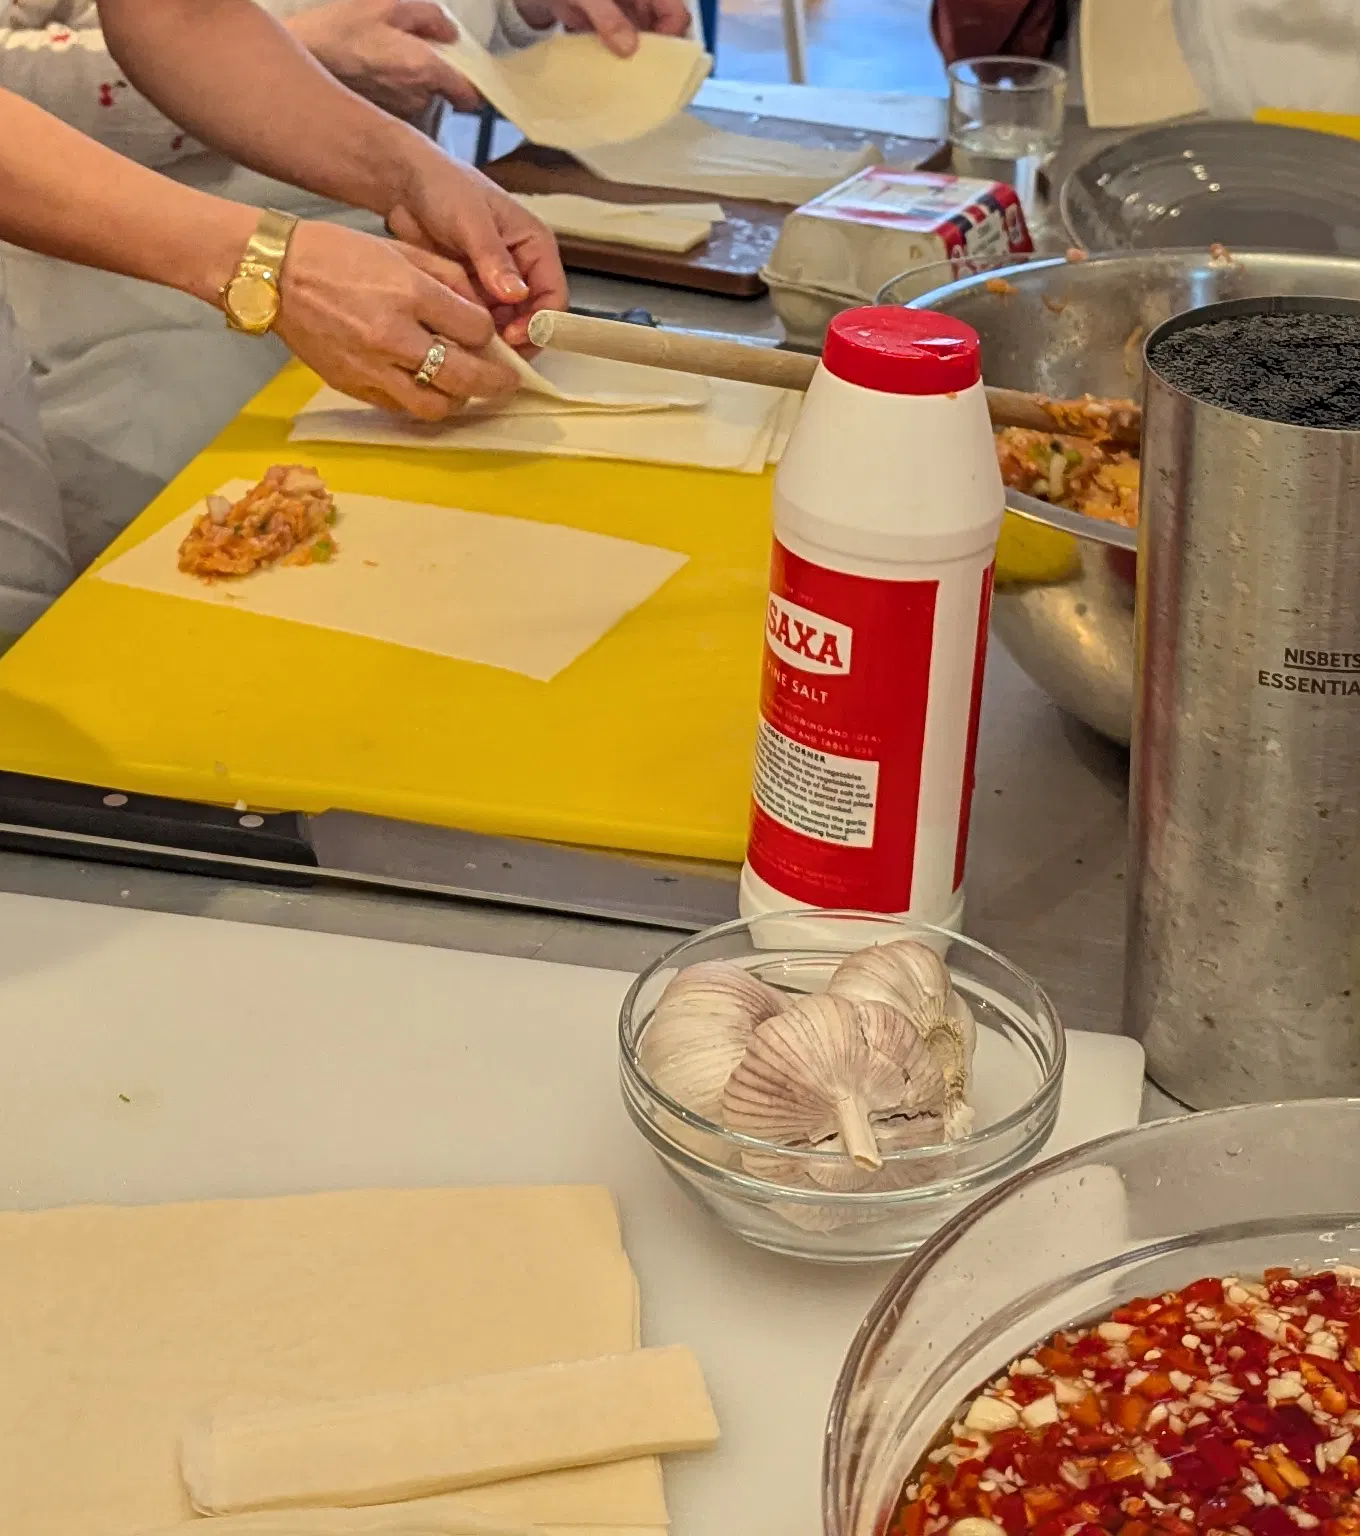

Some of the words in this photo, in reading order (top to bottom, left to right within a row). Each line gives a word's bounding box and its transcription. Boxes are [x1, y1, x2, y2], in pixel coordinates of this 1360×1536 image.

[767, 598, 844, 669] SAXA
[767, 660, 788, 687] FINE
[792, 679, 829, 705] SALT
[788, 742, 827, 765] CORNER
[823, 768, 862, 781] vegetables
